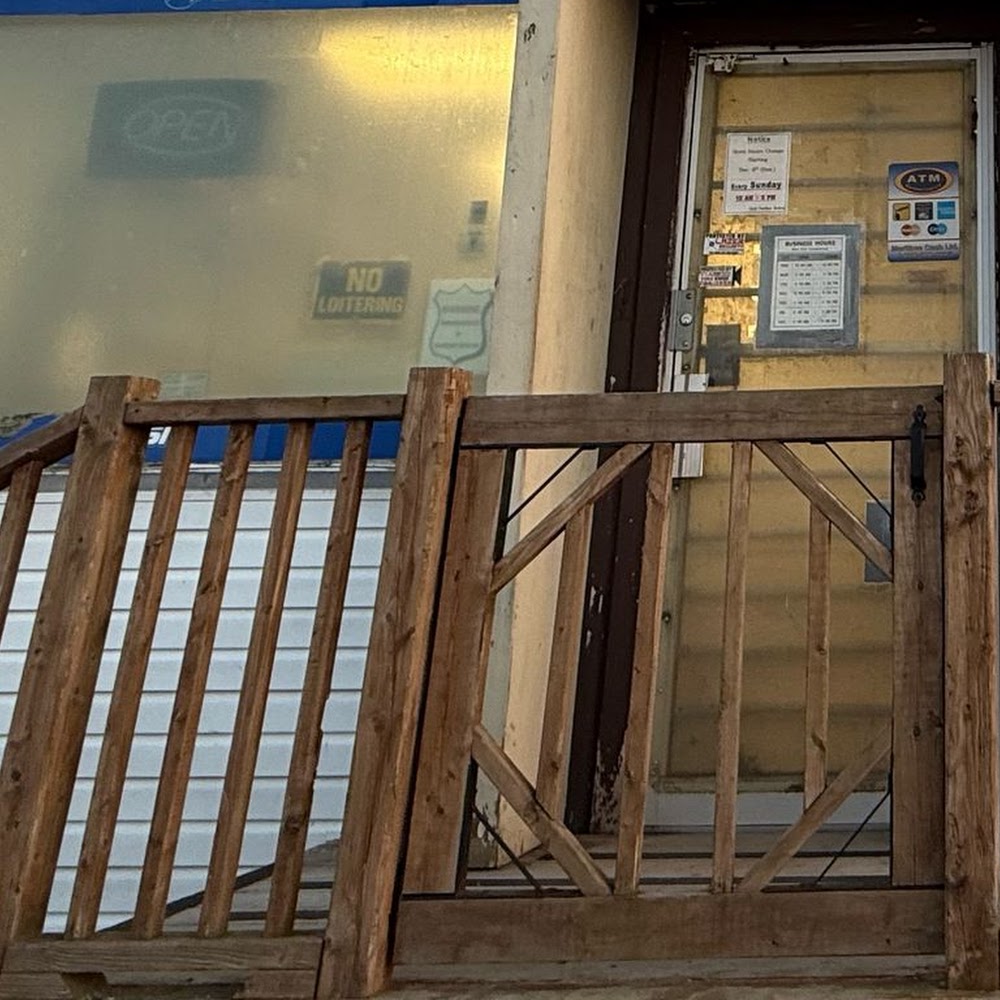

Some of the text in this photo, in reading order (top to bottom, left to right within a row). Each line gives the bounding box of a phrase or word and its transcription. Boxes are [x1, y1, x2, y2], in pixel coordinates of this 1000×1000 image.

[907, 174, 940, 183] ATM
[750, 181, 781, 190] Sunday
[345, 267, 382, 292] NO
[318, 296, 405, 313] LOITERING
